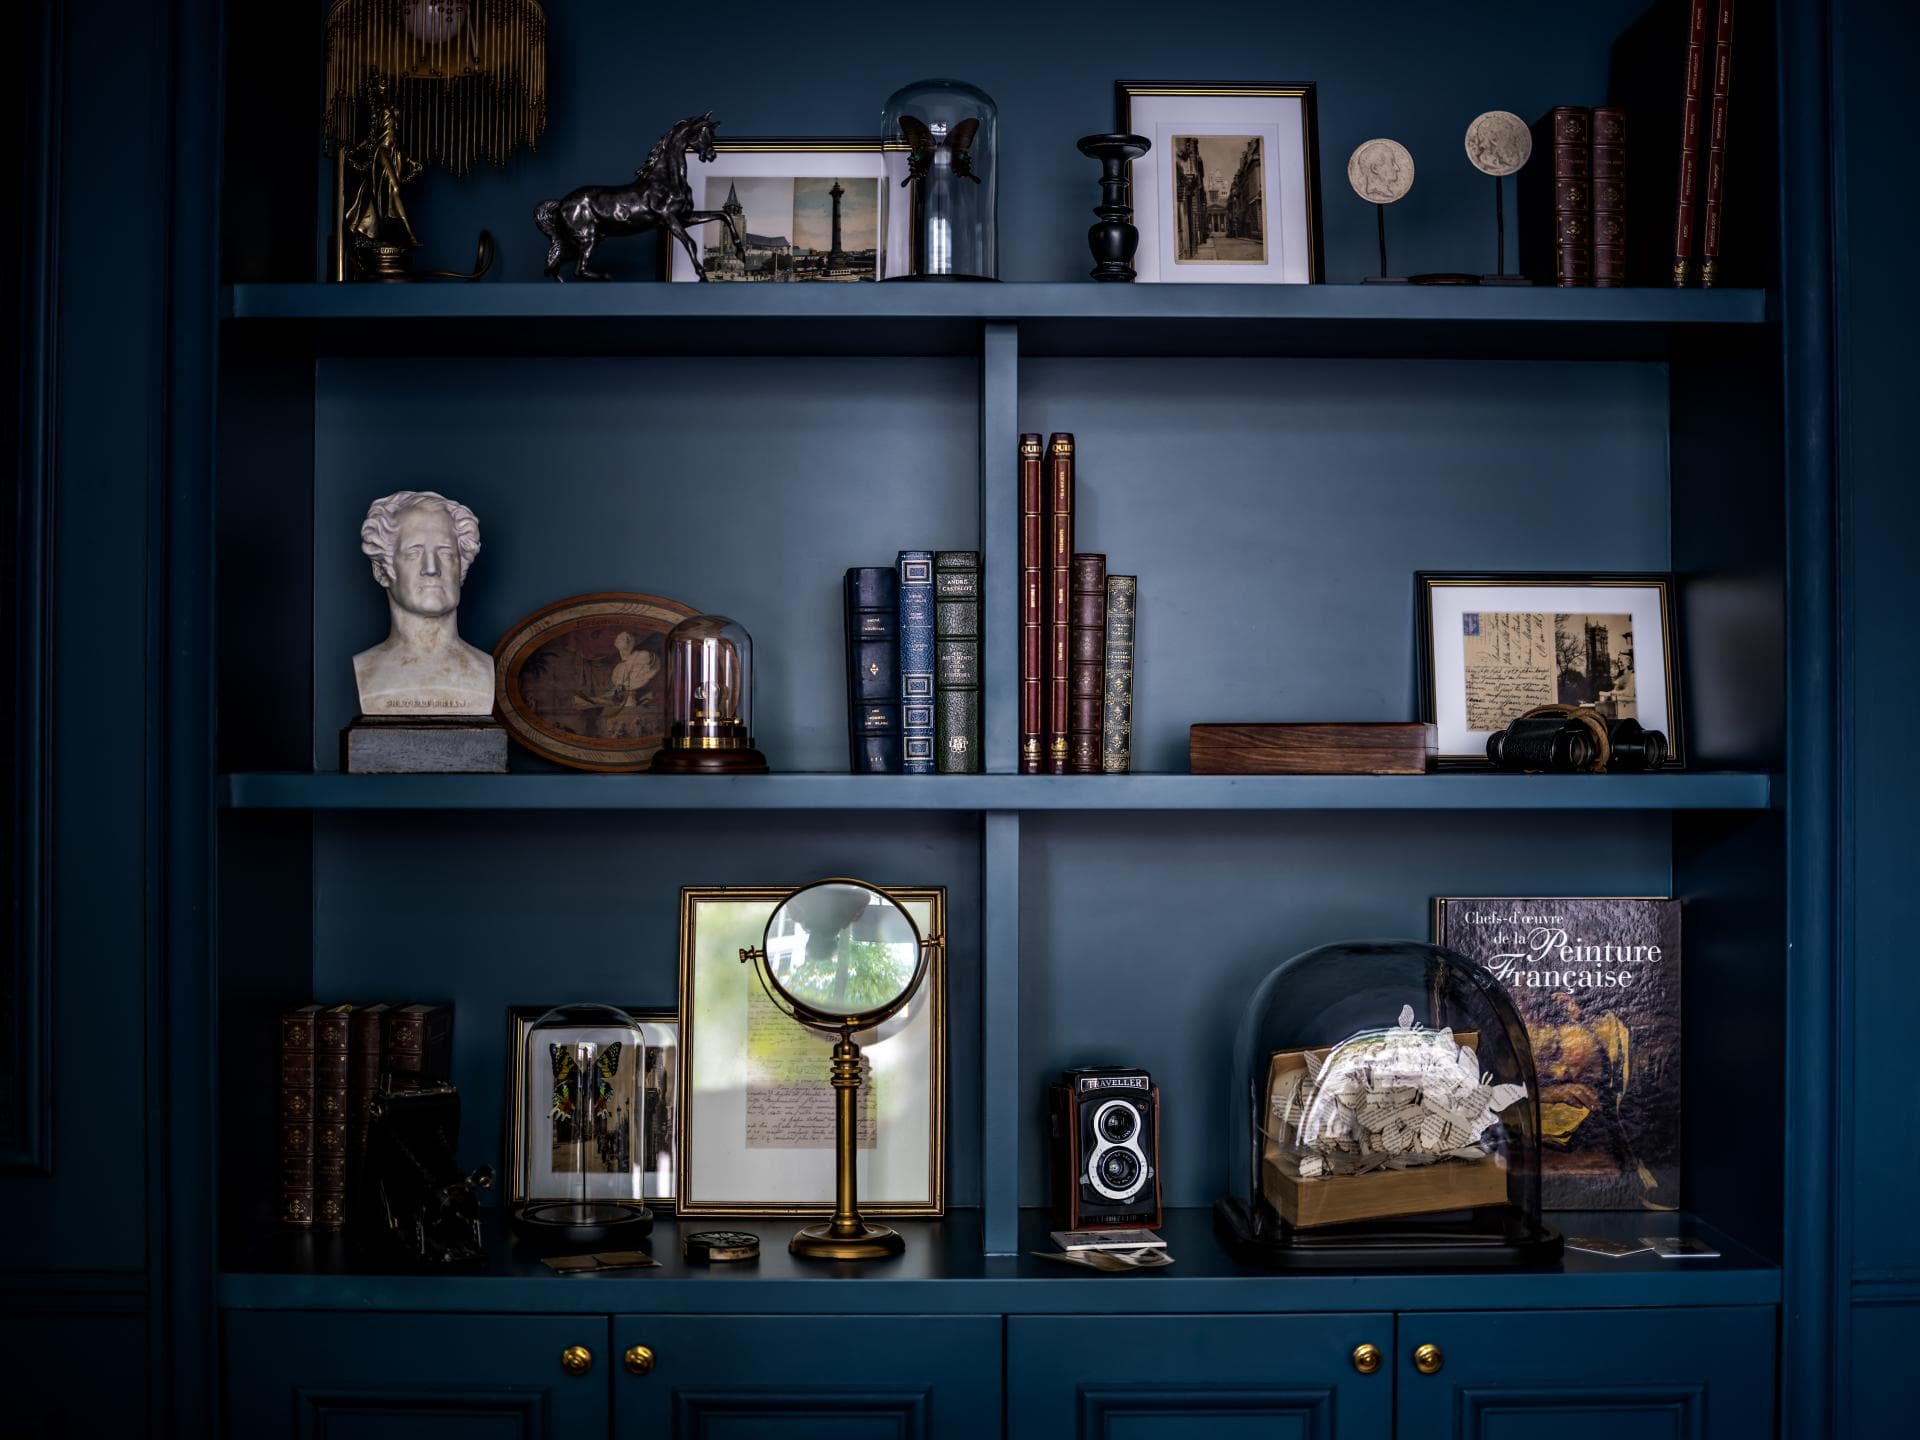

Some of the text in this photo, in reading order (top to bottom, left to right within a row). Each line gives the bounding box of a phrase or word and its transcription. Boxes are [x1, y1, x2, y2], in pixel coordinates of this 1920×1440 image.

[1021, 444, 1042, 454] QUID
[1052, 443, 1073, 453] QUID
[1493, 927, 1662, 963] de la Peinture
[1482, 953, 1632, 994] Française
[1087, 1078, 1142, 1089] TRAVELLER
